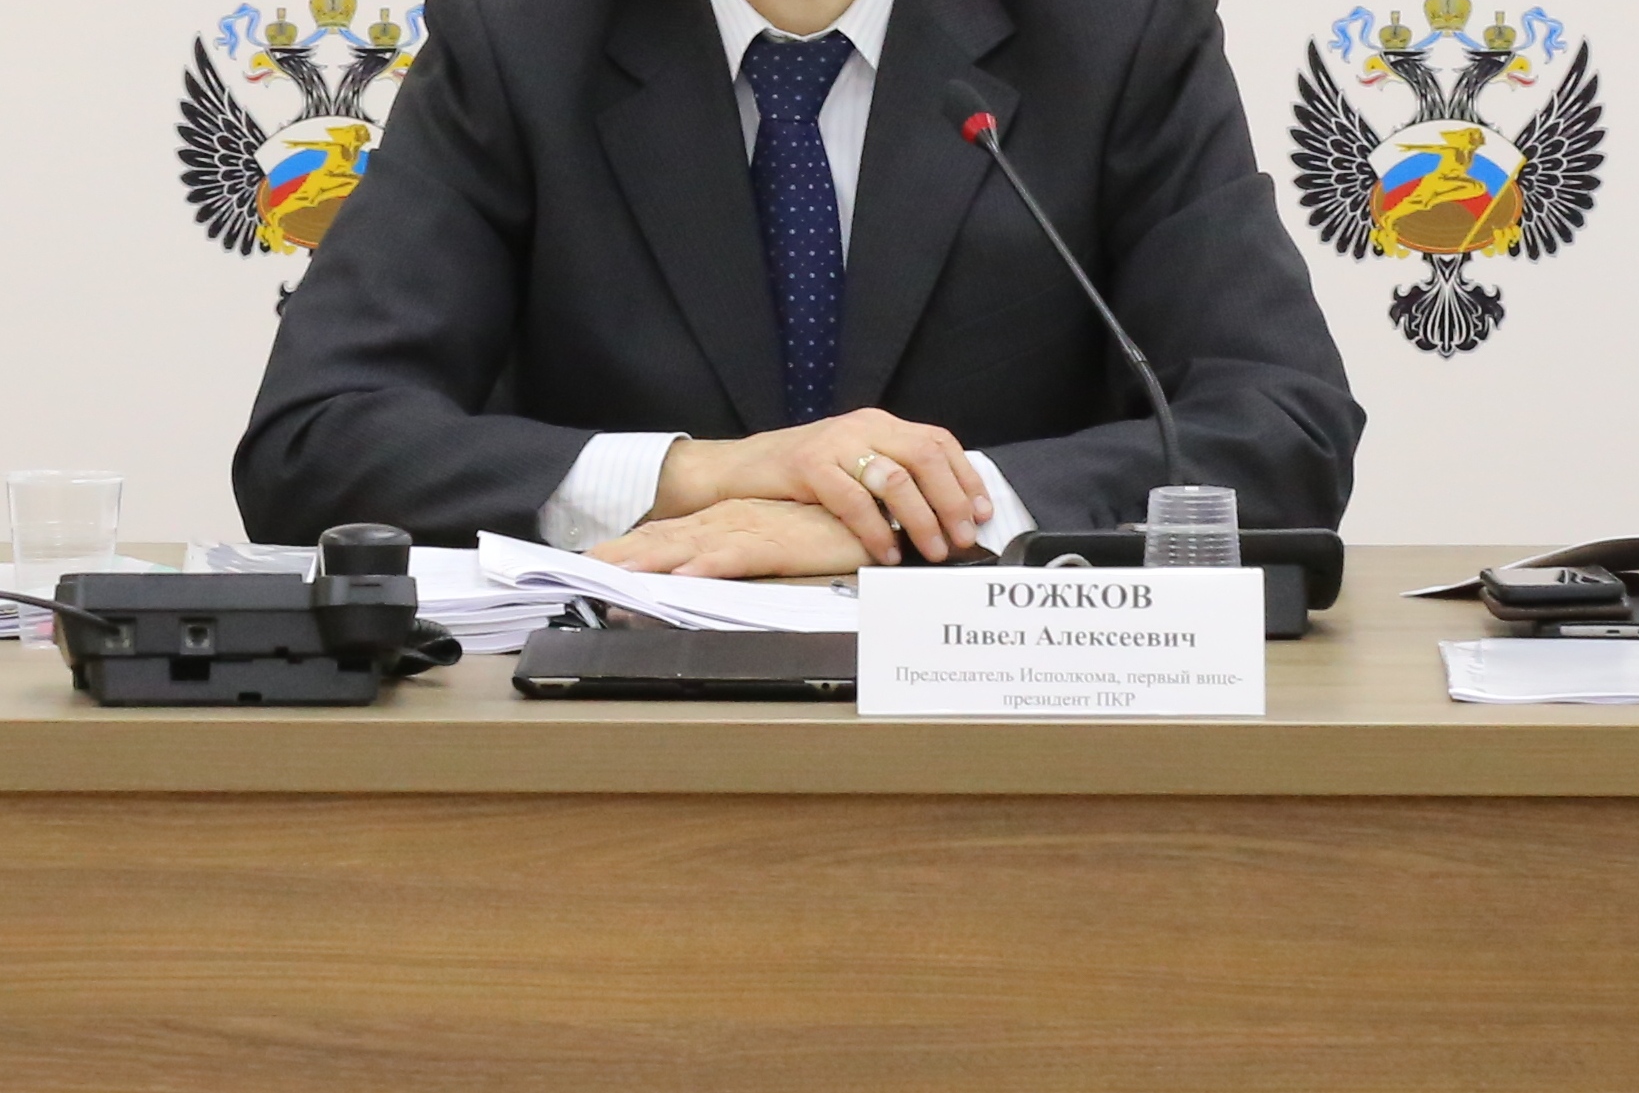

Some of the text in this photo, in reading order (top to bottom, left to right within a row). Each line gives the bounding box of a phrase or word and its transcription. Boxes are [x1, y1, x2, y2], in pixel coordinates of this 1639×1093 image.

[986, 582, 1153, 609] РОЖКОВ
[942, 624, 1196, 648] Павел Алексеевич
[895, 667, 1243, 688] Председатель Исполкома, первый вице-
[1003, 691, 1136, 710] президент ПКР
